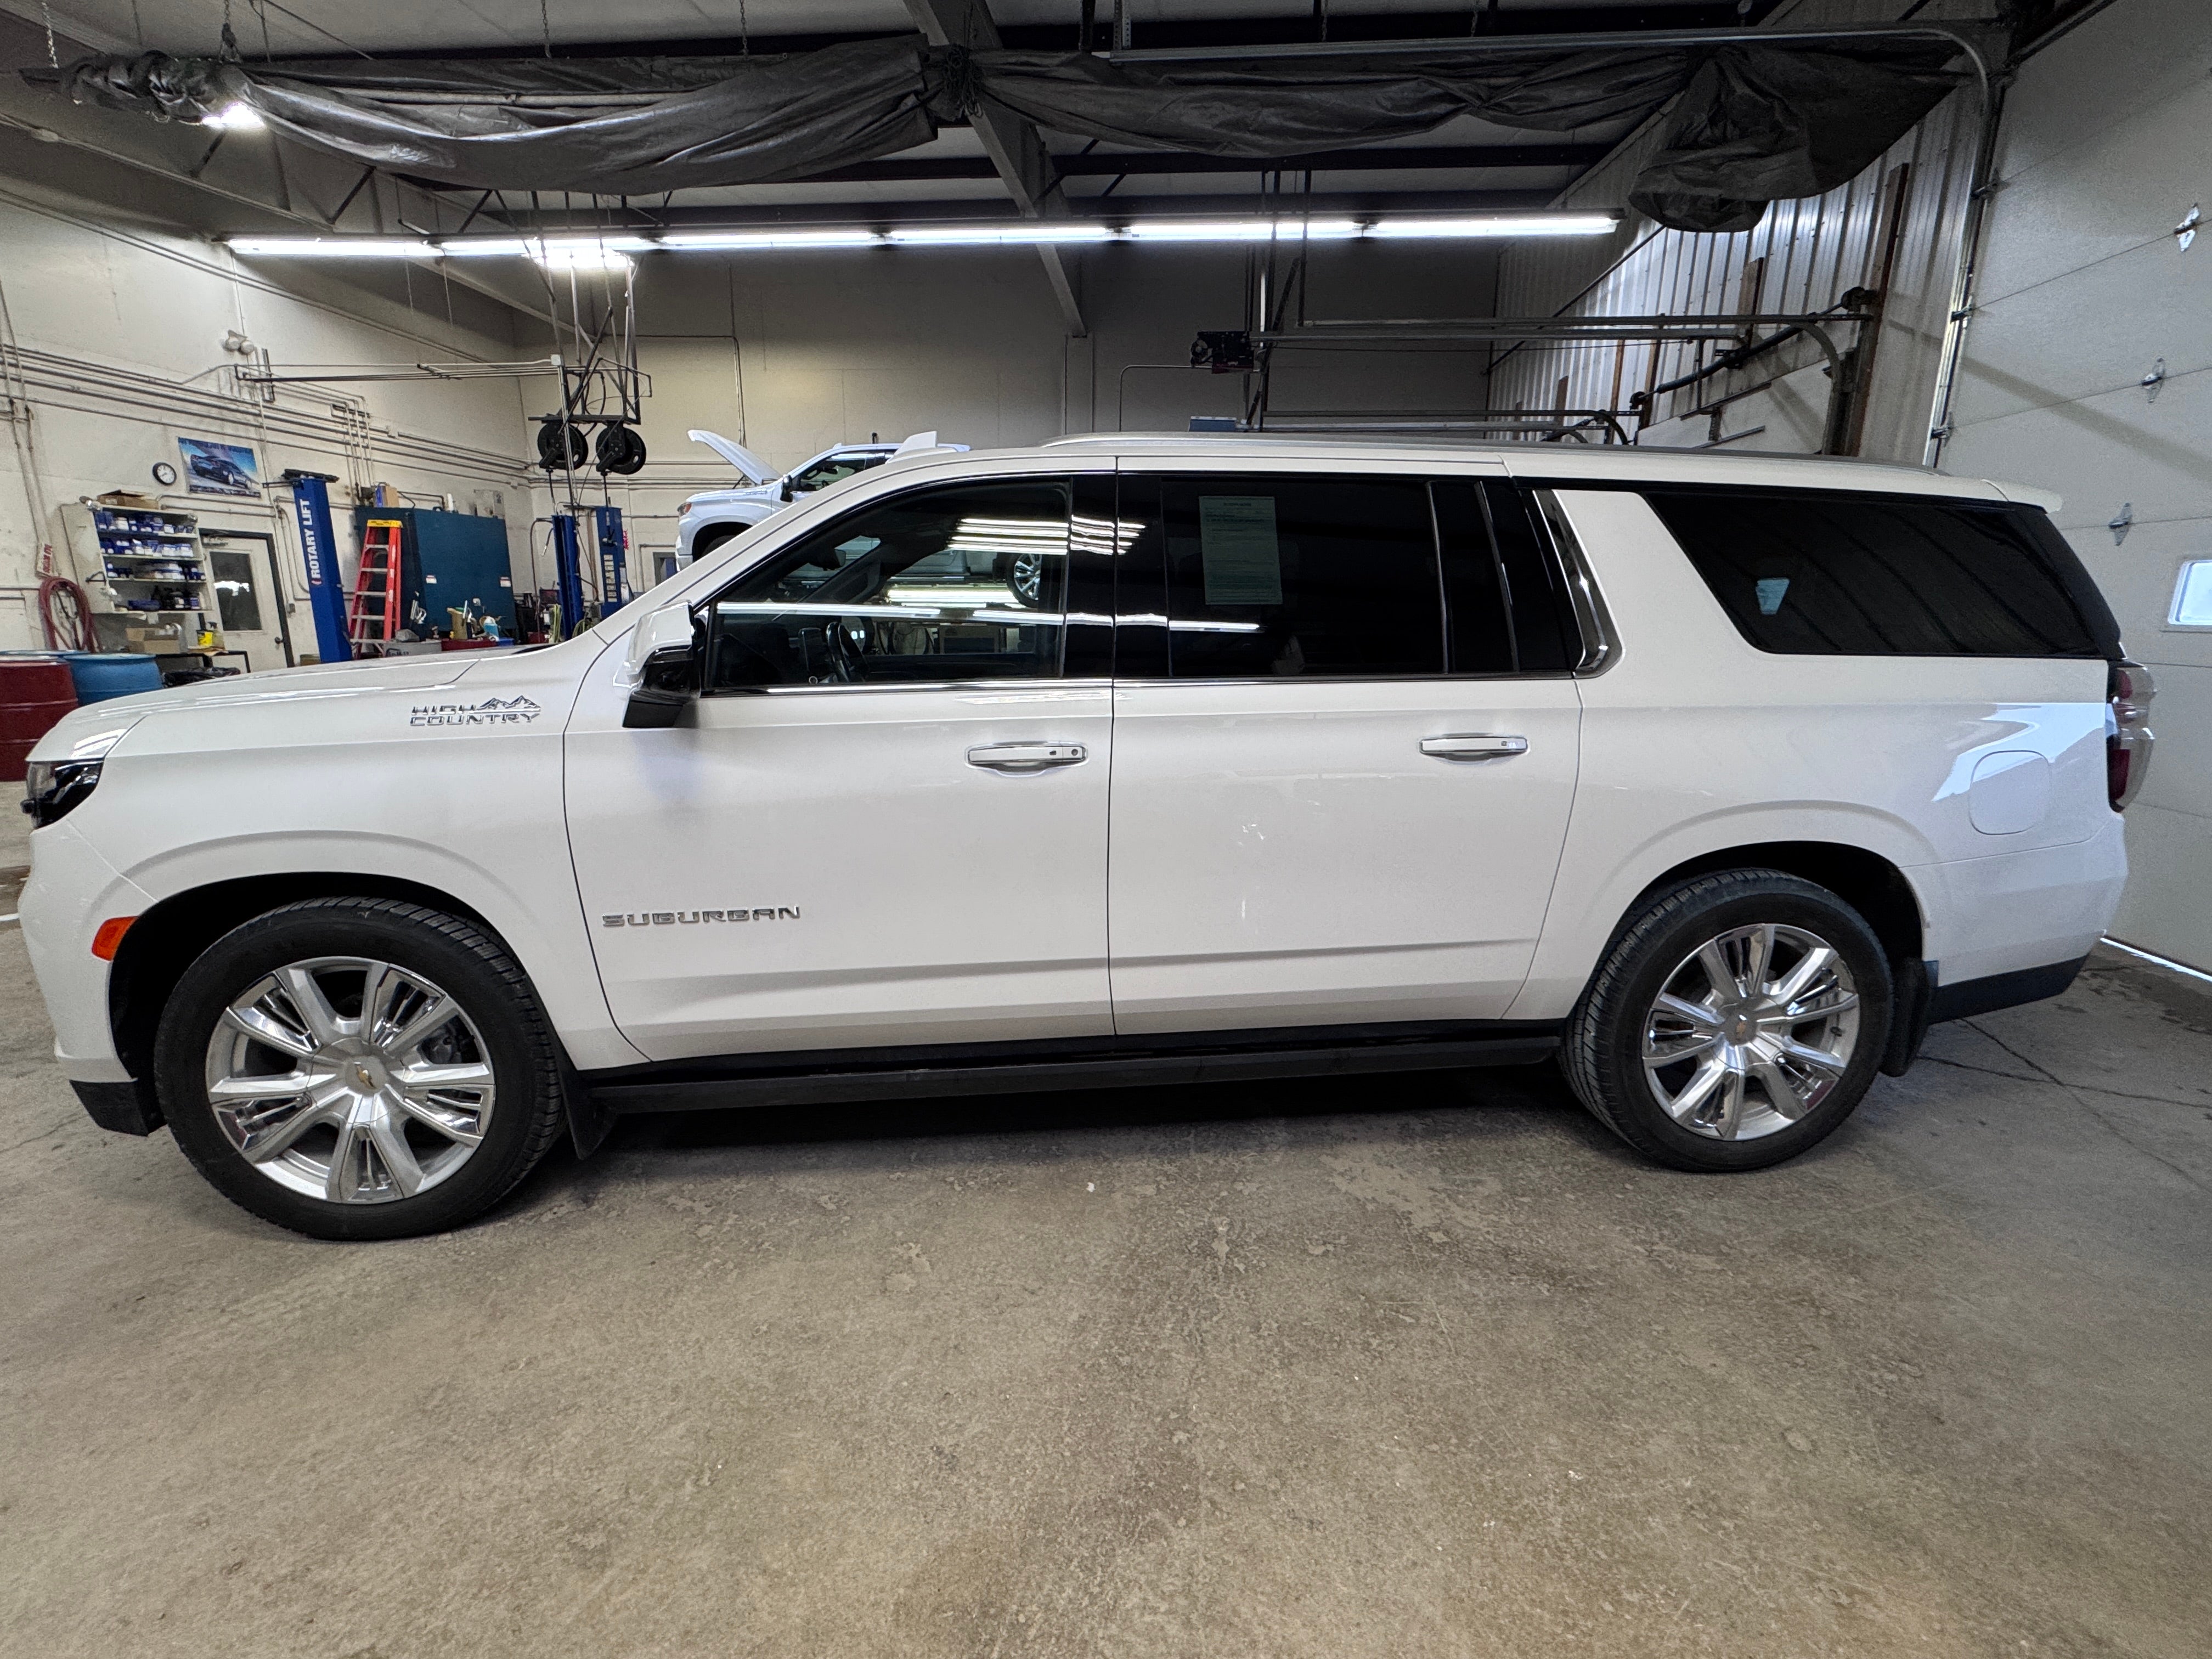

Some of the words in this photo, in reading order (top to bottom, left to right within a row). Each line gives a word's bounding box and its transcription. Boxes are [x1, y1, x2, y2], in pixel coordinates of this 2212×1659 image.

[300, 499, 313, 526] LIFT
[304, 528, 321, 578] ROTARY
[410, 713, 540, 726] COUNTRY
[411, 704, 476, 715] HIGH
[602, 905, 801, 927] SUBURBAN
